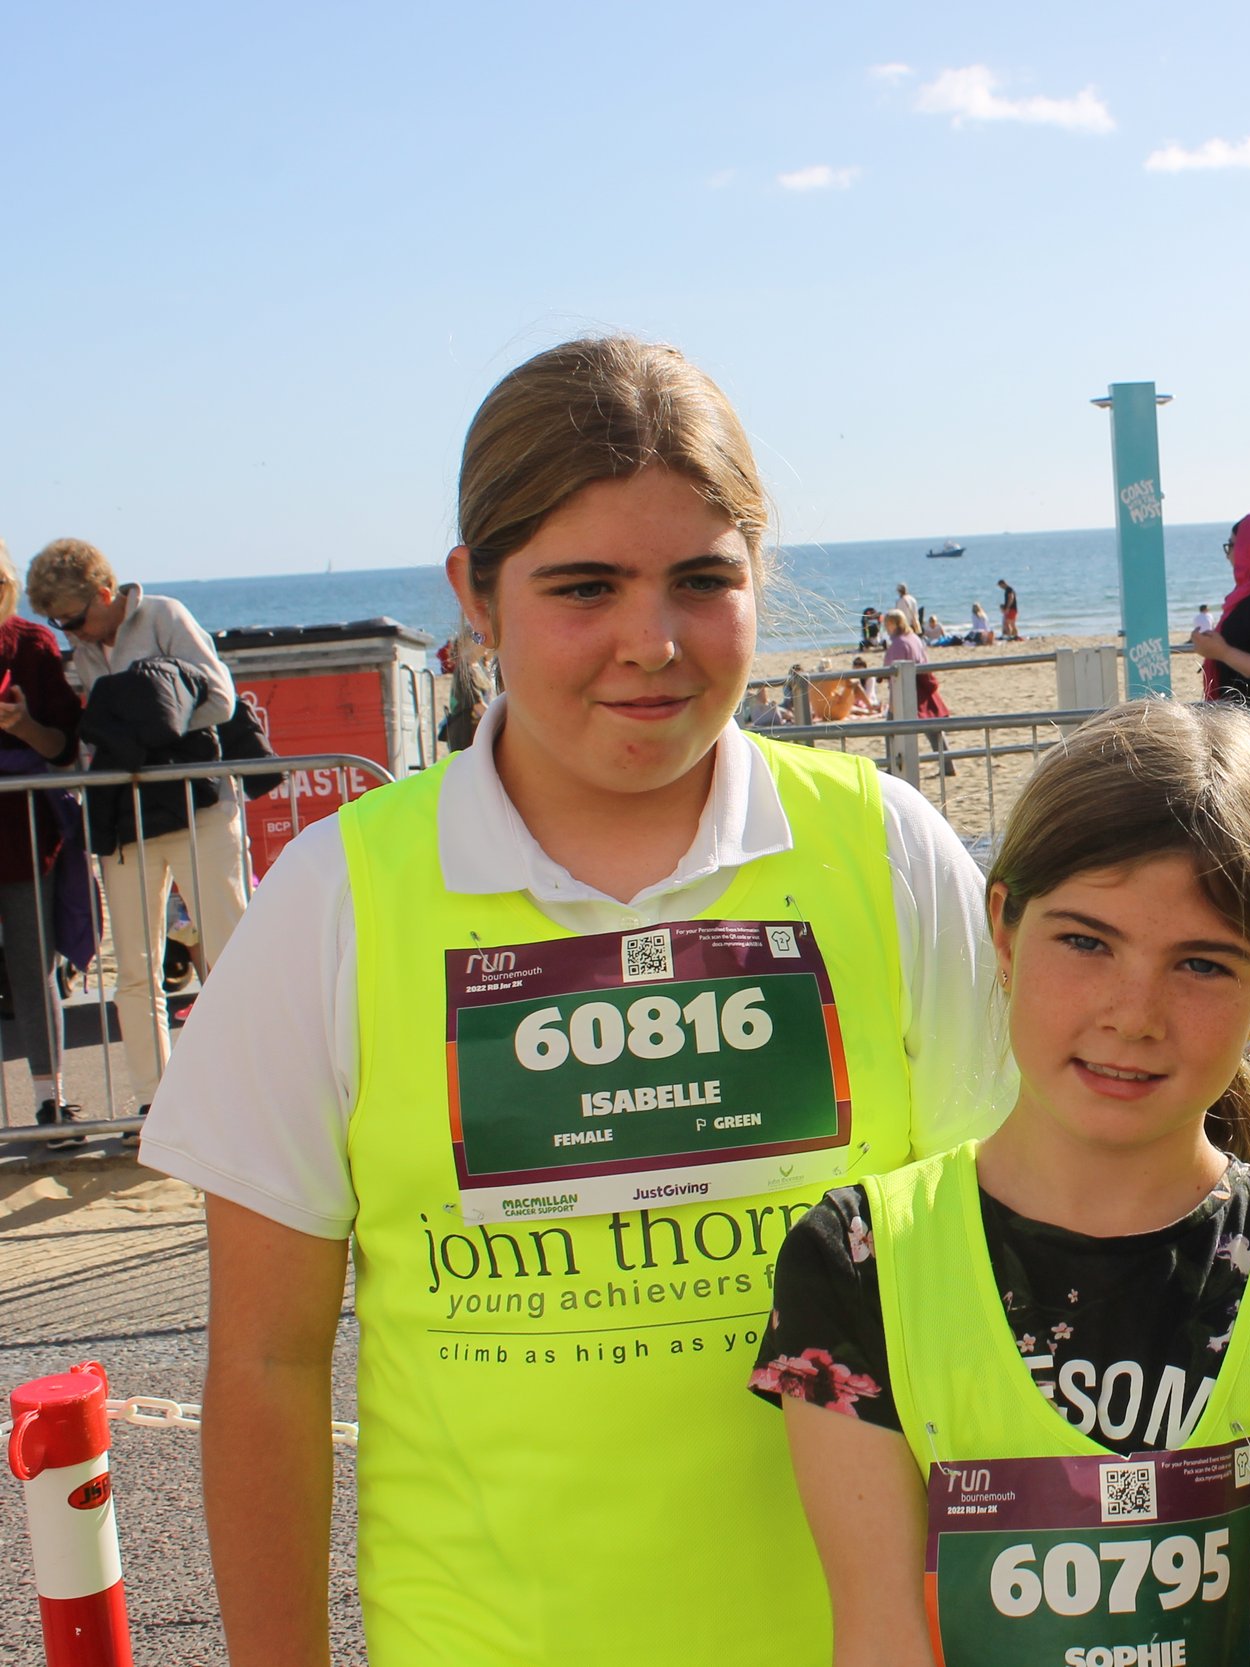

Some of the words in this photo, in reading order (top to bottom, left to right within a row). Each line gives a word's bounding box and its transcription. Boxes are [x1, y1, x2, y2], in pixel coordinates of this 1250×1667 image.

[1120, 480, 1154, 504] COAST
[1130, 503, 1161, 523] MOST
[1129, 638, 1162, 662] COAST
[1138, 660, 1169, 681] MOST
[267, 821, 291, 833] BCP
[465, 951, 516, 974] run
[482, 966, 543, 982] bournemouth
[465, 985, 487, 994] 2022
[487, 983, 499, 991] RB
[513, 987, 773, 1072] 60816
[580, 1080, 722, 1117] ISABELLE
[553, 1128, 614, 1147] FEMALE
[713, 1112, 762, 1130] GREEN
[502, 1193, 578, 1210] MACMILLAN
[633, 1182, 709, 1200] JustGiving
[505, 1206, 537, 1217] CANCER
[538, 1204, 574, 1215] SUPPORT
[421, 1213, 580, 1294] john
[447, 1292, 545, 1319] young
[560, 1273, 752, 1310] achievers
[440, 1343, 508, 1363] climb
[525, 1350, 556, 1364] as
[576, 1340, 648, 1365] high
[670, 1337, 704, 1354] as
[947, 1469, 990, 1493] run
[961, 1491, 1016, 1503] bournemouth
[947, 1506, 965, 1515] 2022
[990, 1527, 1231, 1617] 60795
[1064, 1639, 1186, 1667] SOPHIE
